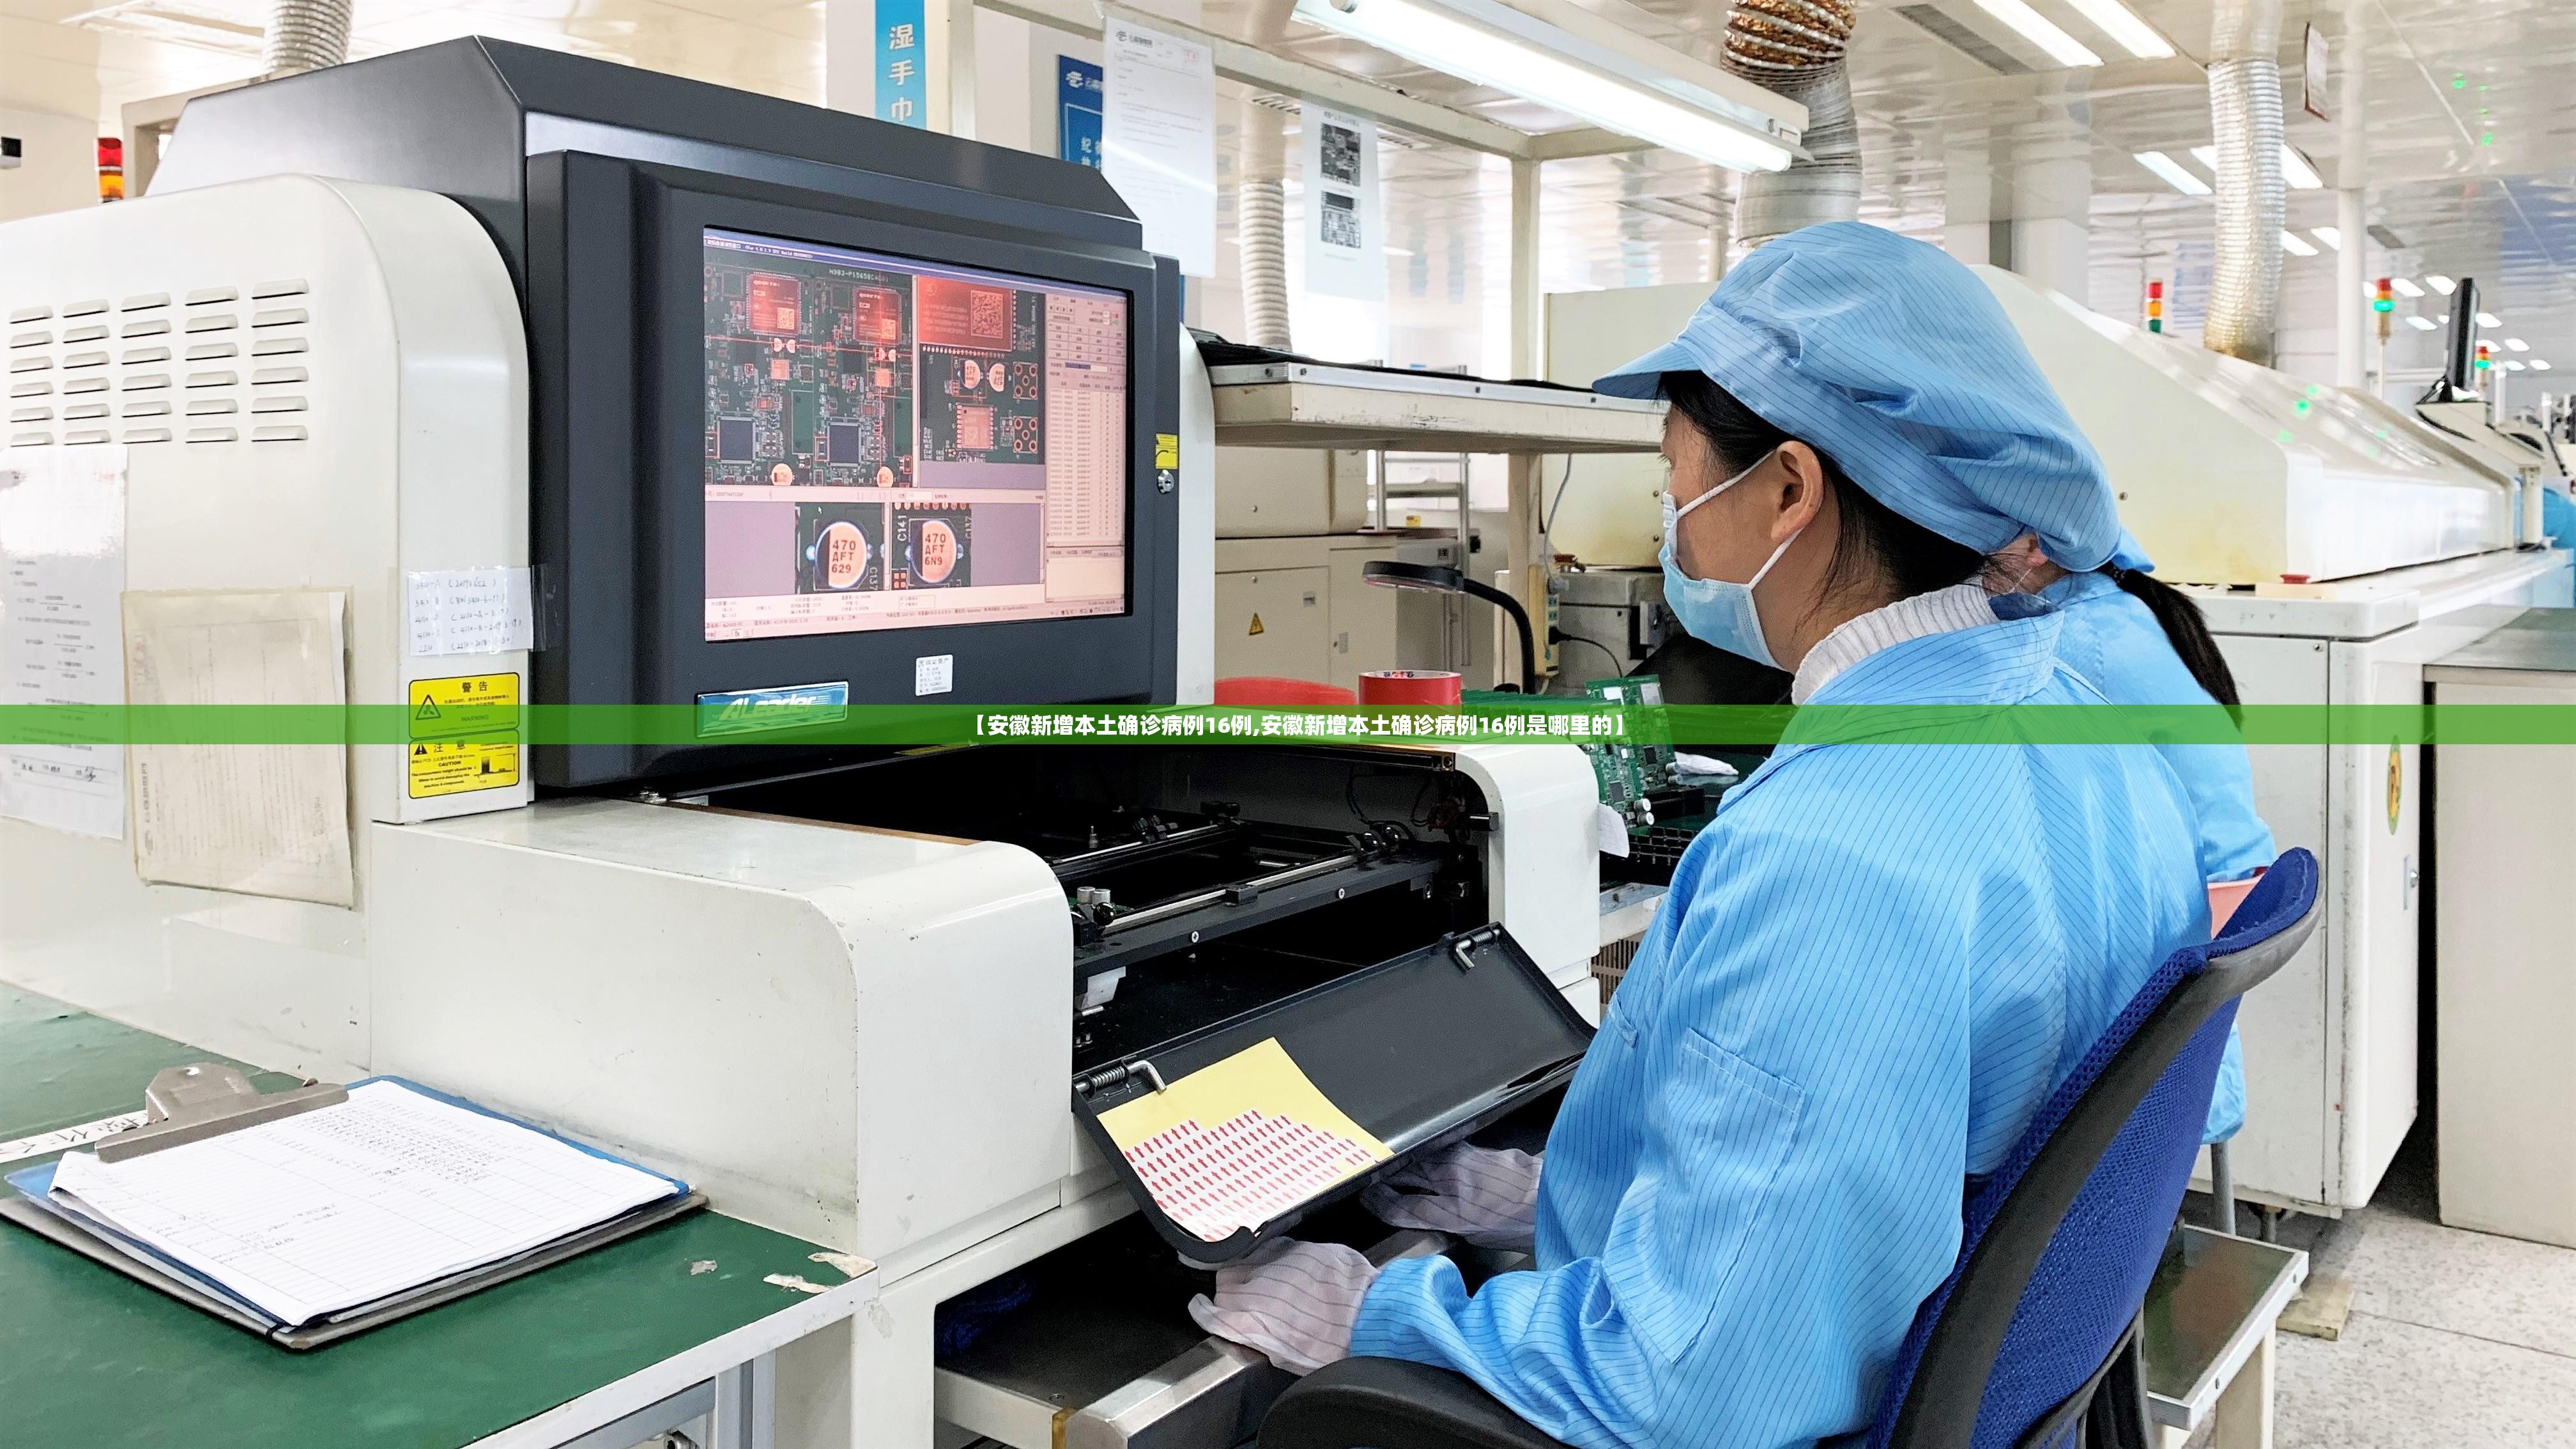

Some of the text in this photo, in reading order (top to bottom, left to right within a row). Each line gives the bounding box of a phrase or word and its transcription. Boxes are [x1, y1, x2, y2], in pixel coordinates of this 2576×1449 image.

[889, 24, 915, 121] 湿手巾
[897, 515, 907, 541] C141
[924, 533, 946, 544] 470
[832, 539, 857, 551] 470
[924, 544, 946, 555] AFT
[832, 551, 854, 562] AFT
[924, 556, 943, 566] 6N9
[831, 564, 852, 574] 629
[869, 567, 878, 591] C137
[462, 680, 488, 693] 警告
[719, 693, 818, 721] ALeader
[434, 740, 466, 753] 注意
